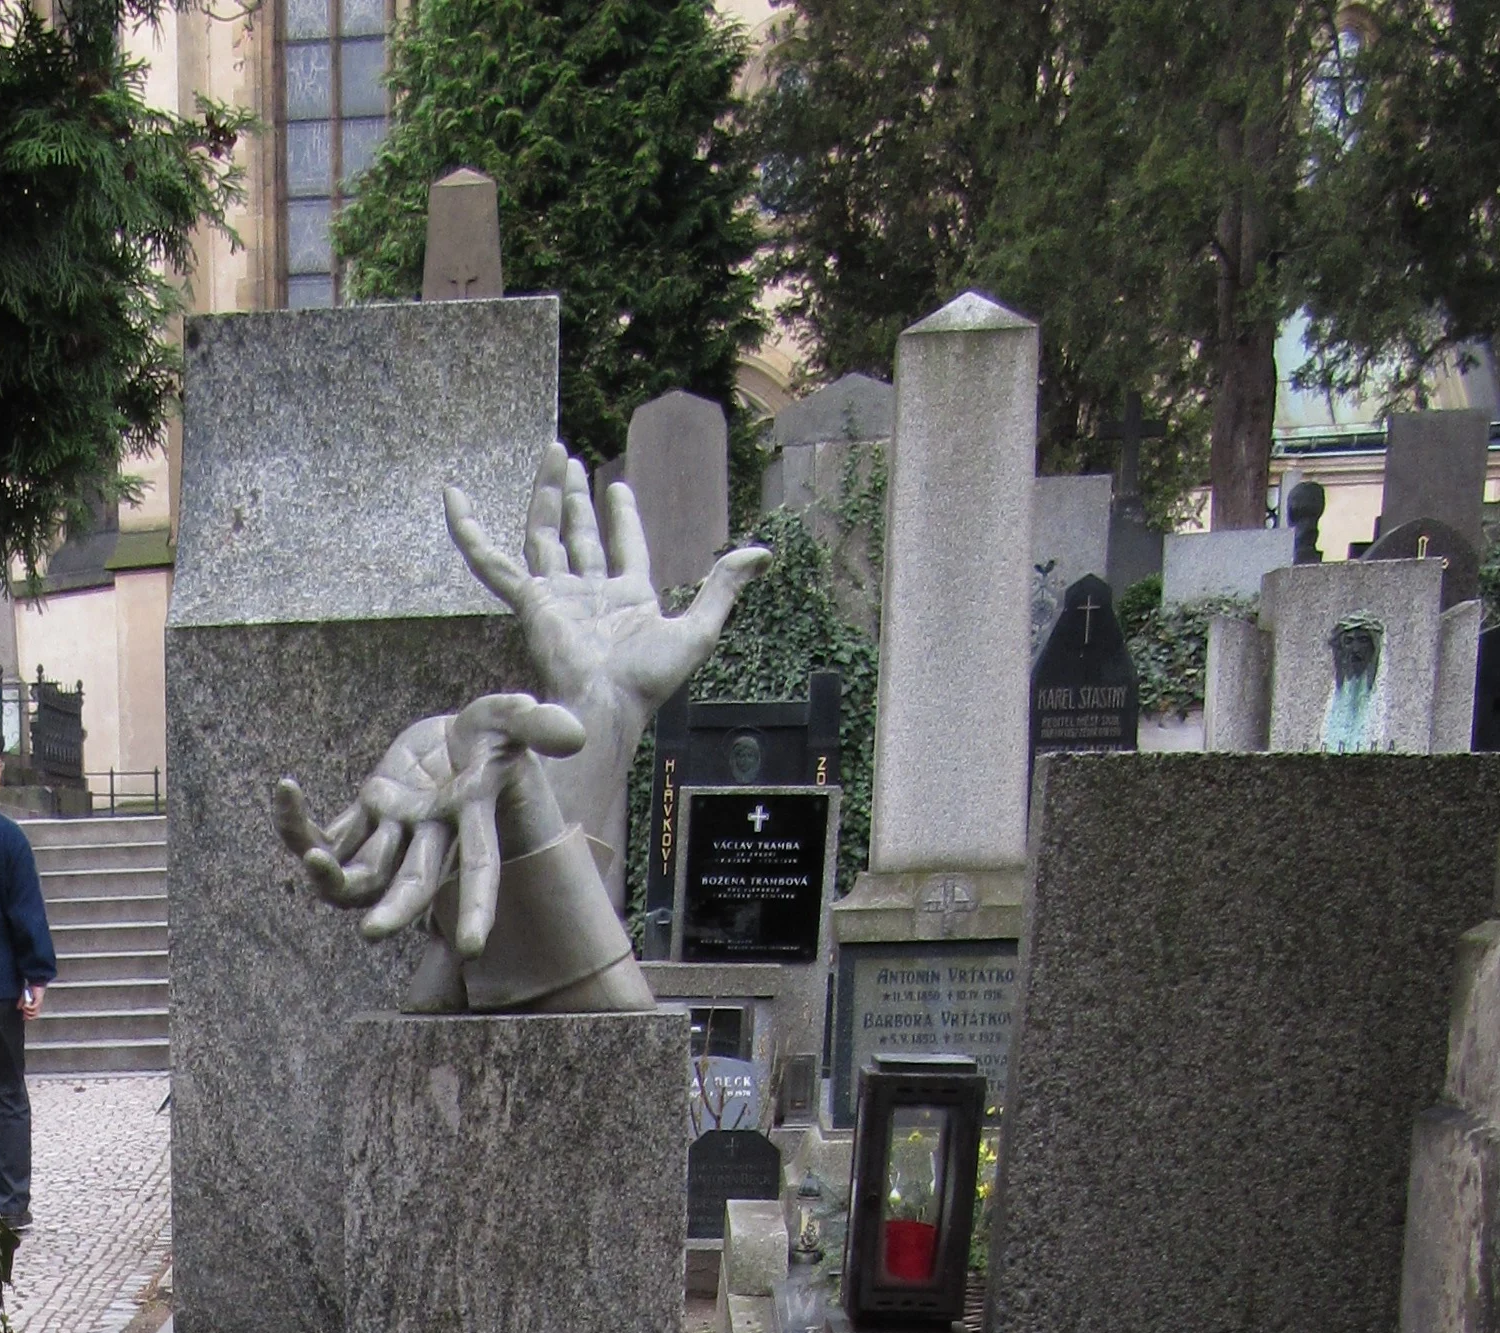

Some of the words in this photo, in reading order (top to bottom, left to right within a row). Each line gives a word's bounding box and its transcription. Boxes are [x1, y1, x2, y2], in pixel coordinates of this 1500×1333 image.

[1038, 688, 1075, 710] KAREL
[661, 759, 675, 875] HLAVKOVI
[713, 841, 753, 850] VÁCLAV
[757, 842, 800, 851] TRAMBA
[702, 875, 746, 886] BOŽENA
[750, 875, 809, 886] TRAMBOVÁ
[863, 1011, 933, 1030] BARBORA
